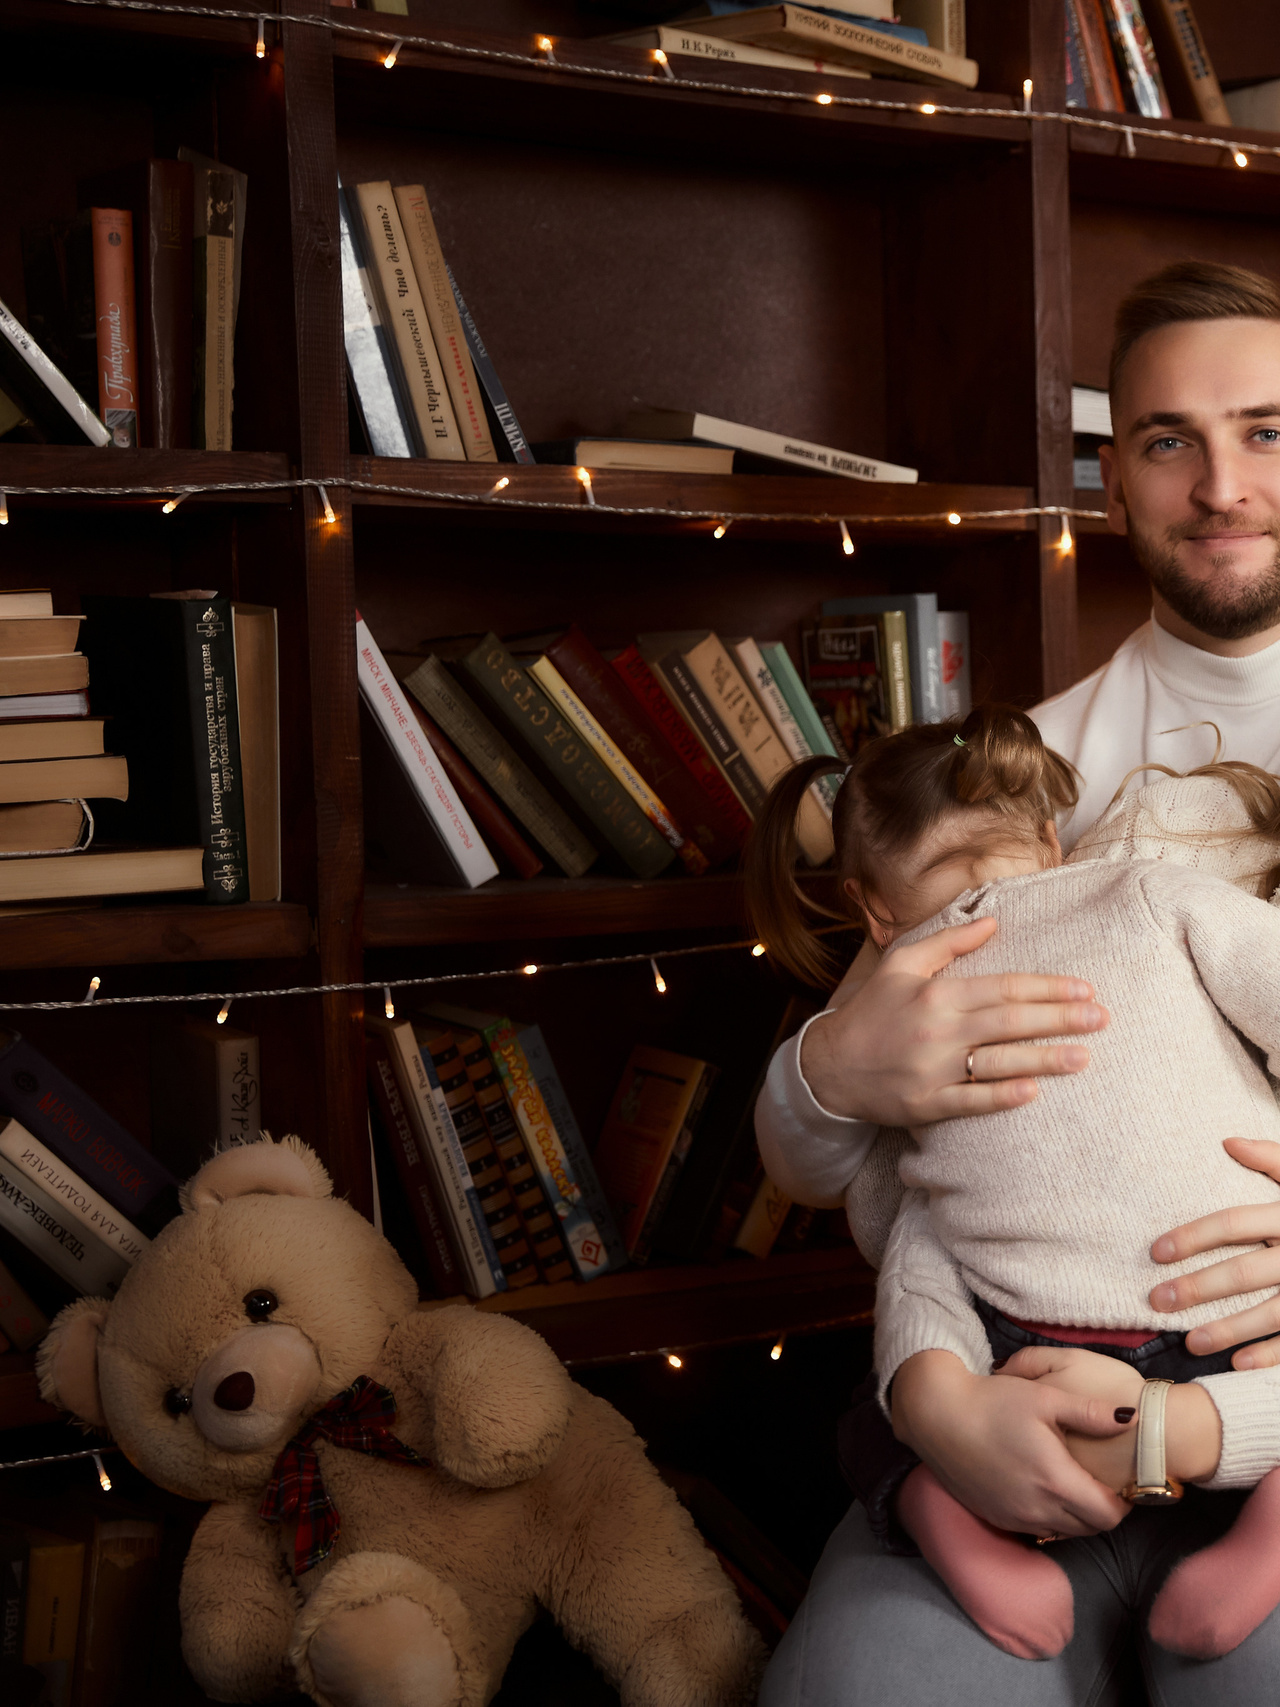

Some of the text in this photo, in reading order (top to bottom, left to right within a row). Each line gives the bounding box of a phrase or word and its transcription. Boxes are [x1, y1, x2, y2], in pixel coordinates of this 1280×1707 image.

[215, 237, 227, 313] ОСКОРБЛЕННЫЕ
[371, 203, 402, 265] делать?
[390, 266, 410, 298] Что
[98, 301, 134, 403] Правхупада
[215, 323, 227, 385] УНИЖЕННЫЕ
[400, 306, 444, 413] Чернышевский
[493, 400, 526, 453] КРИСТИ
[200, 642, 224, 825] История государства и права
[213, 676, 234, 792] зарубежных стран
[359, 646, 384, 680] МІНСК
[377, 682, 412, 730] МІНЧАНЕ:
[402, 728, 430, 767] ДЗЕСЯЦЬ
[34, 1088, 151, 1198] МАРКО ВОВЧОК
[374, 1057, 406, 1117] МАРК
[392, 1113, 422, 1167] ТВЕН
[497, 1041, 546, 1127] ЗАЛАТЫЯ
[534, 1125, 576, 1198] КАЛАСКІ
[17, 1147, 145, 1262] ИГА ДЛЯ РОДИТЕЛЕЙ
[1, 1596, 20, 1658] ИВАН
